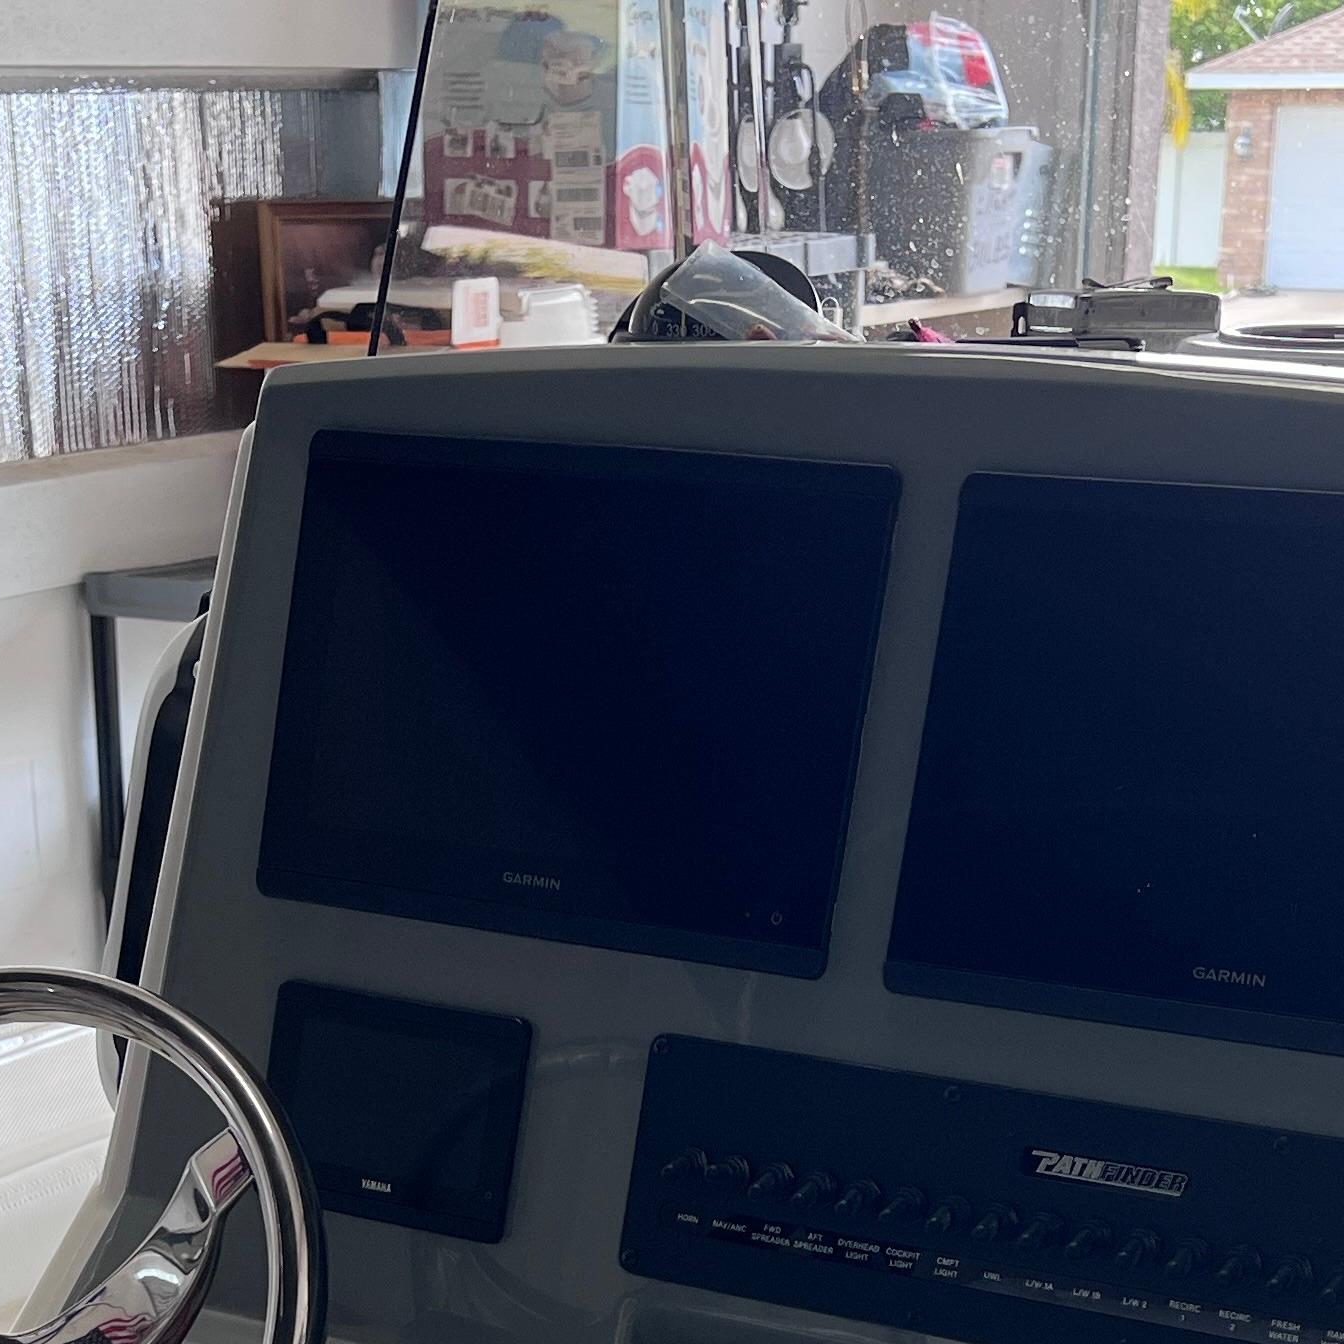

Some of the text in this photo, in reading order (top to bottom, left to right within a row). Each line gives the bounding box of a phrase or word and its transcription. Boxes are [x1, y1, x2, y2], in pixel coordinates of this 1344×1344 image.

[502, 871, 561, 891] GARMIN
[1192, 966, 1267, 988] GARMIN
[1031, 1149, 1189, 1197] PATHFINDER
[361, 1178, 392, 1193] YAMAHA
[677, 1212, 699, 1224] HORN
[763, 1223, 782, 1234] FWD
[807, 1232, 824, 1242] AFT
[844, 1251, 870, 1262] LIGHT
[885, 1246, 921, 1261] COCKPIT
[887, 1259, 913, 1270] LIGHT
[934, 1267, 959, 1279] LIGHT
[1271, 1319, 1301, 1331] FRESH
[1268, 1330, 1300, 1344] WATER
